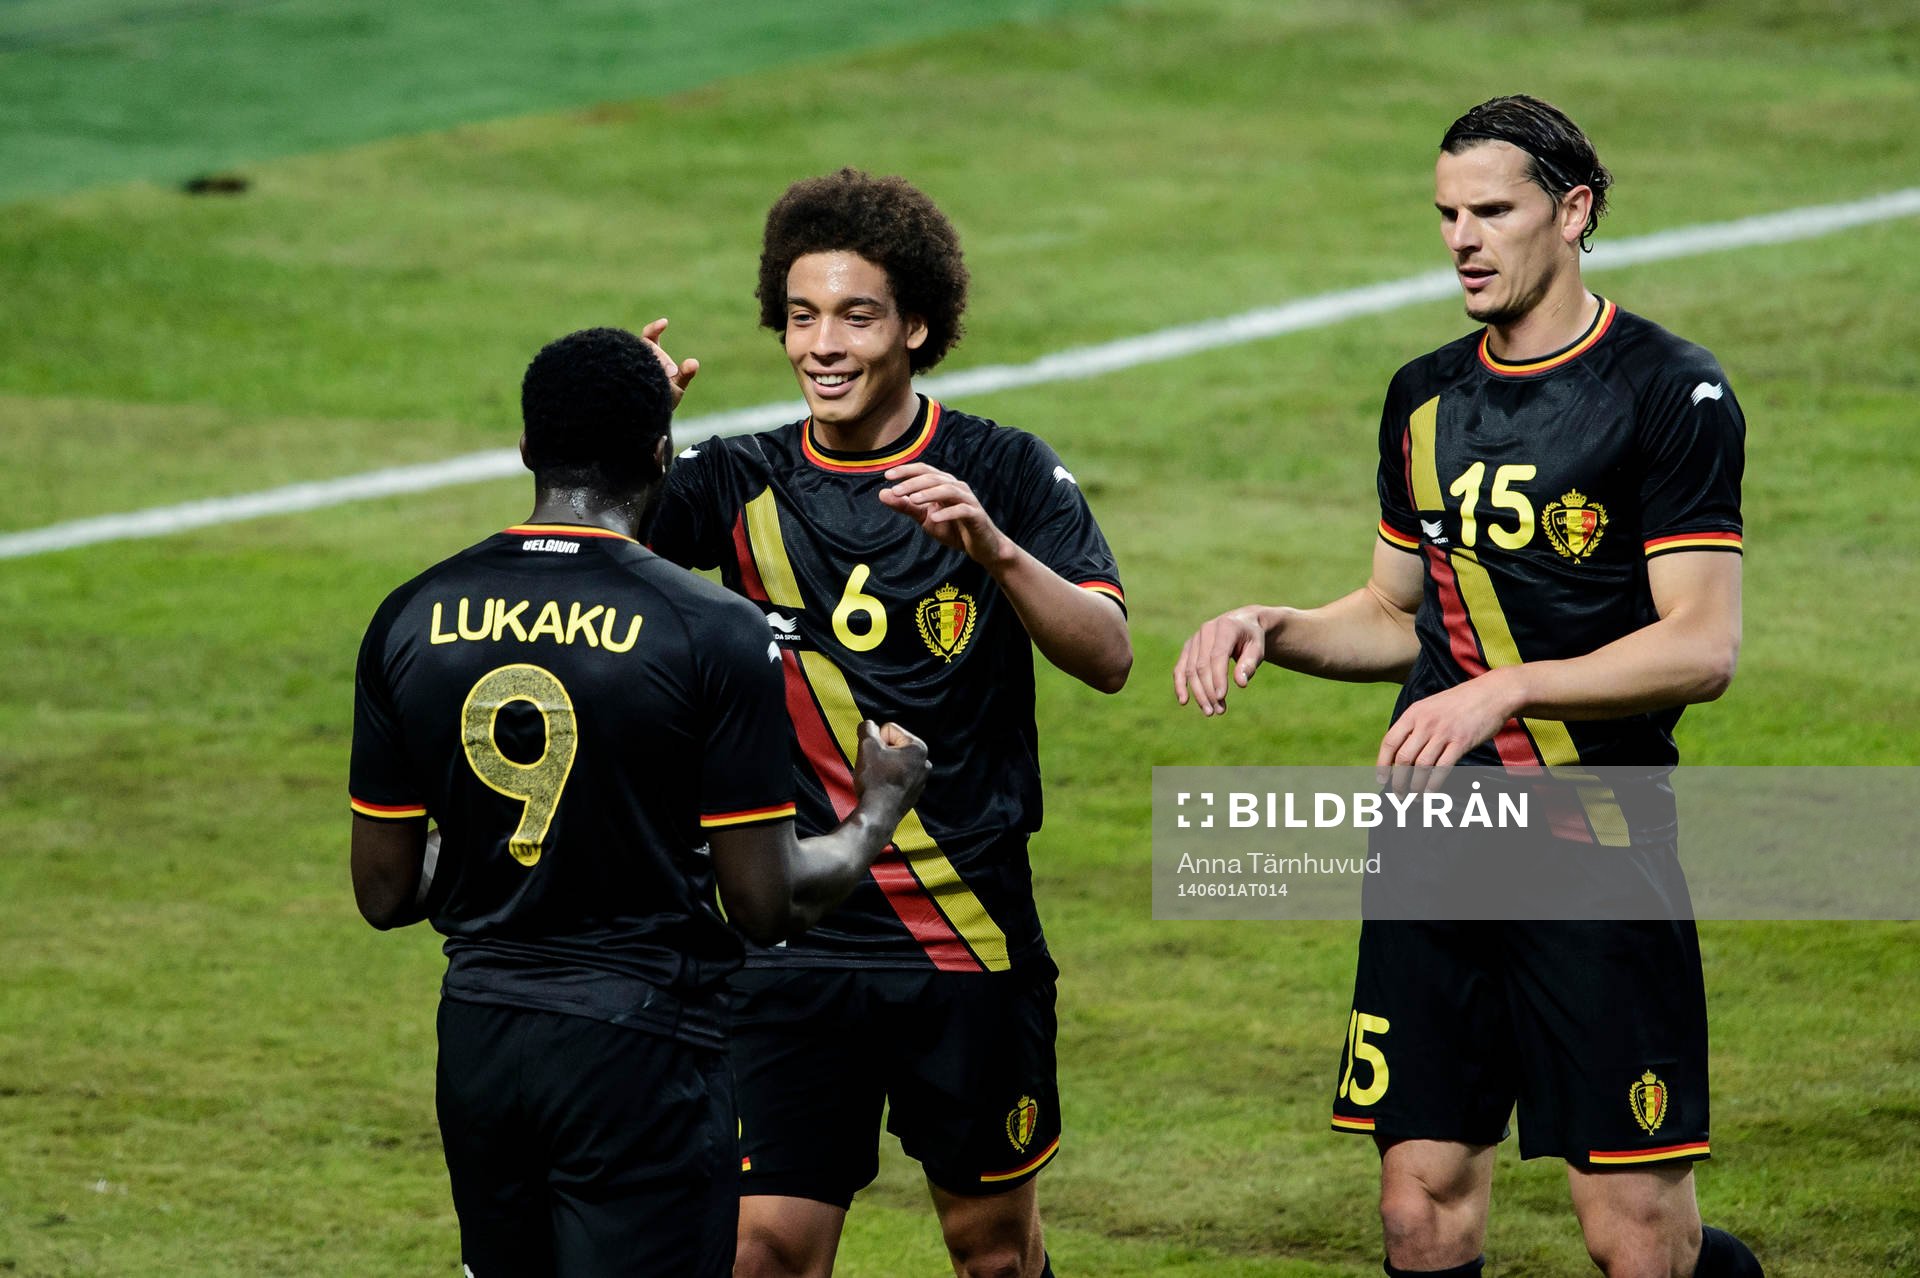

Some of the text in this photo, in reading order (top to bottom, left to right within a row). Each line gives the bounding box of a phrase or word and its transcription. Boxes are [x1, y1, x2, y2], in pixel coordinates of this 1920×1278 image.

[522, 539, 580, 554] BELGIUM
[1449, 461, 1537, 550] 15
[430, 597, 643, 653] LUKAKU
[831, 563, 888, 652] 6
[460, 662, 579, 867] 9
